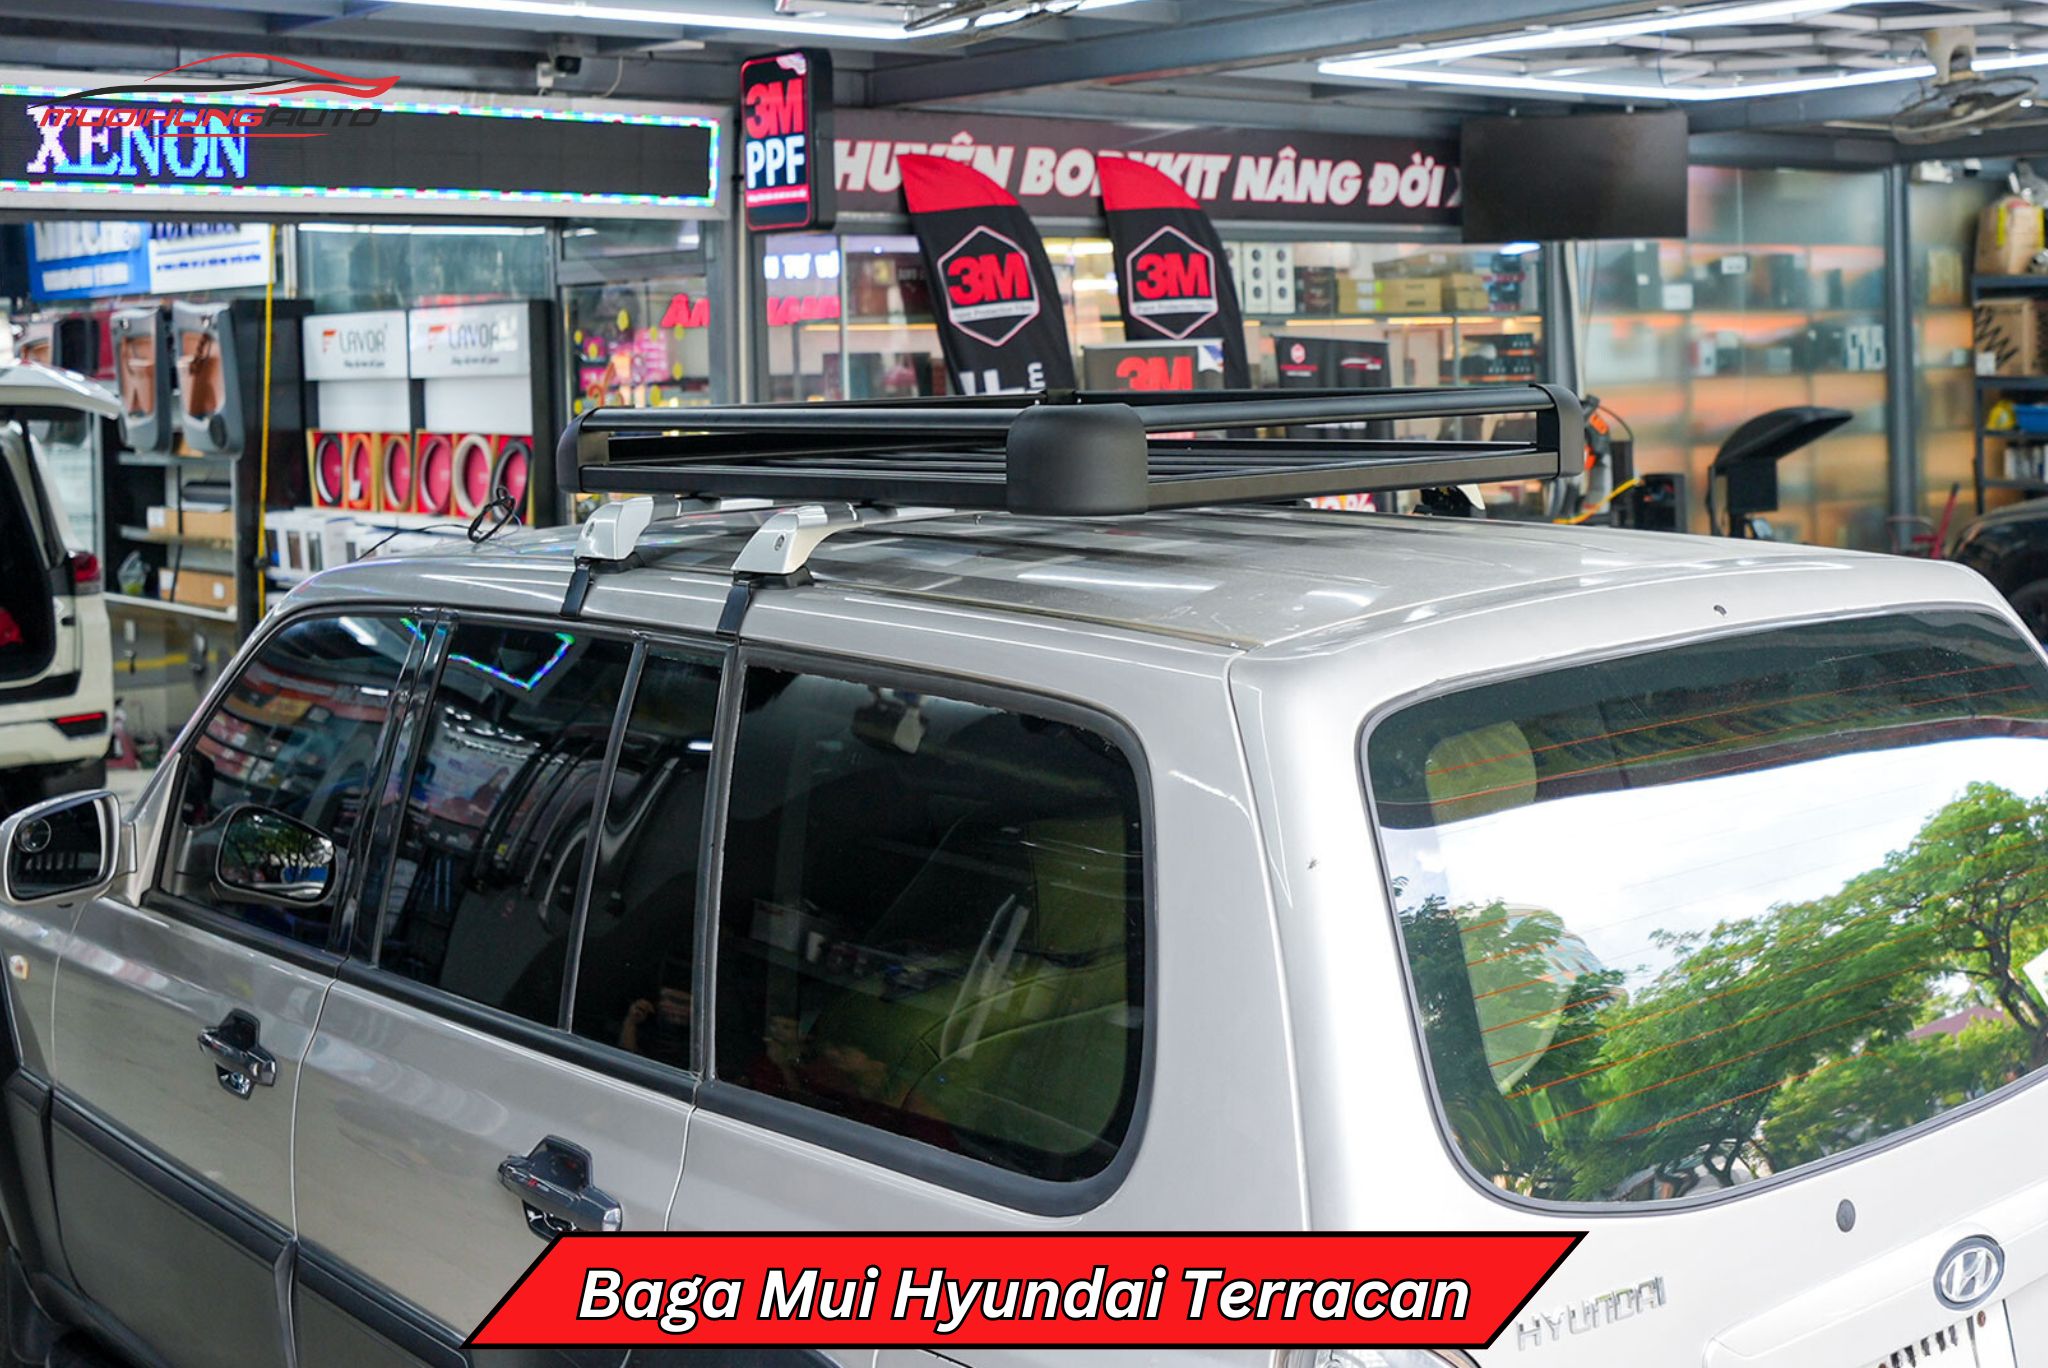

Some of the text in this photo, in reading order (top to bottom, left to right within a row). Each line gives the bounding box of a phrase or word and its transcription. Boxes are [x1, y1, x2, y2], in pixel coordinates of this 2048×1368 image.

[746, 78, 805, 138] 3M
[25, 104, 247, 179] XENON
[746, 135, 806, 190] PPF
[1019, 148, 1232, 200] BOKIT
[1232, 145, 1362, 205] NÂNG
[947, 252, 1031, 306] 3M
[1135, 252, 1211, 299] 3M
[1115, 356, 1193, 391] 3M
[1515, 1276, 1667, 1352] HYUNDAI
